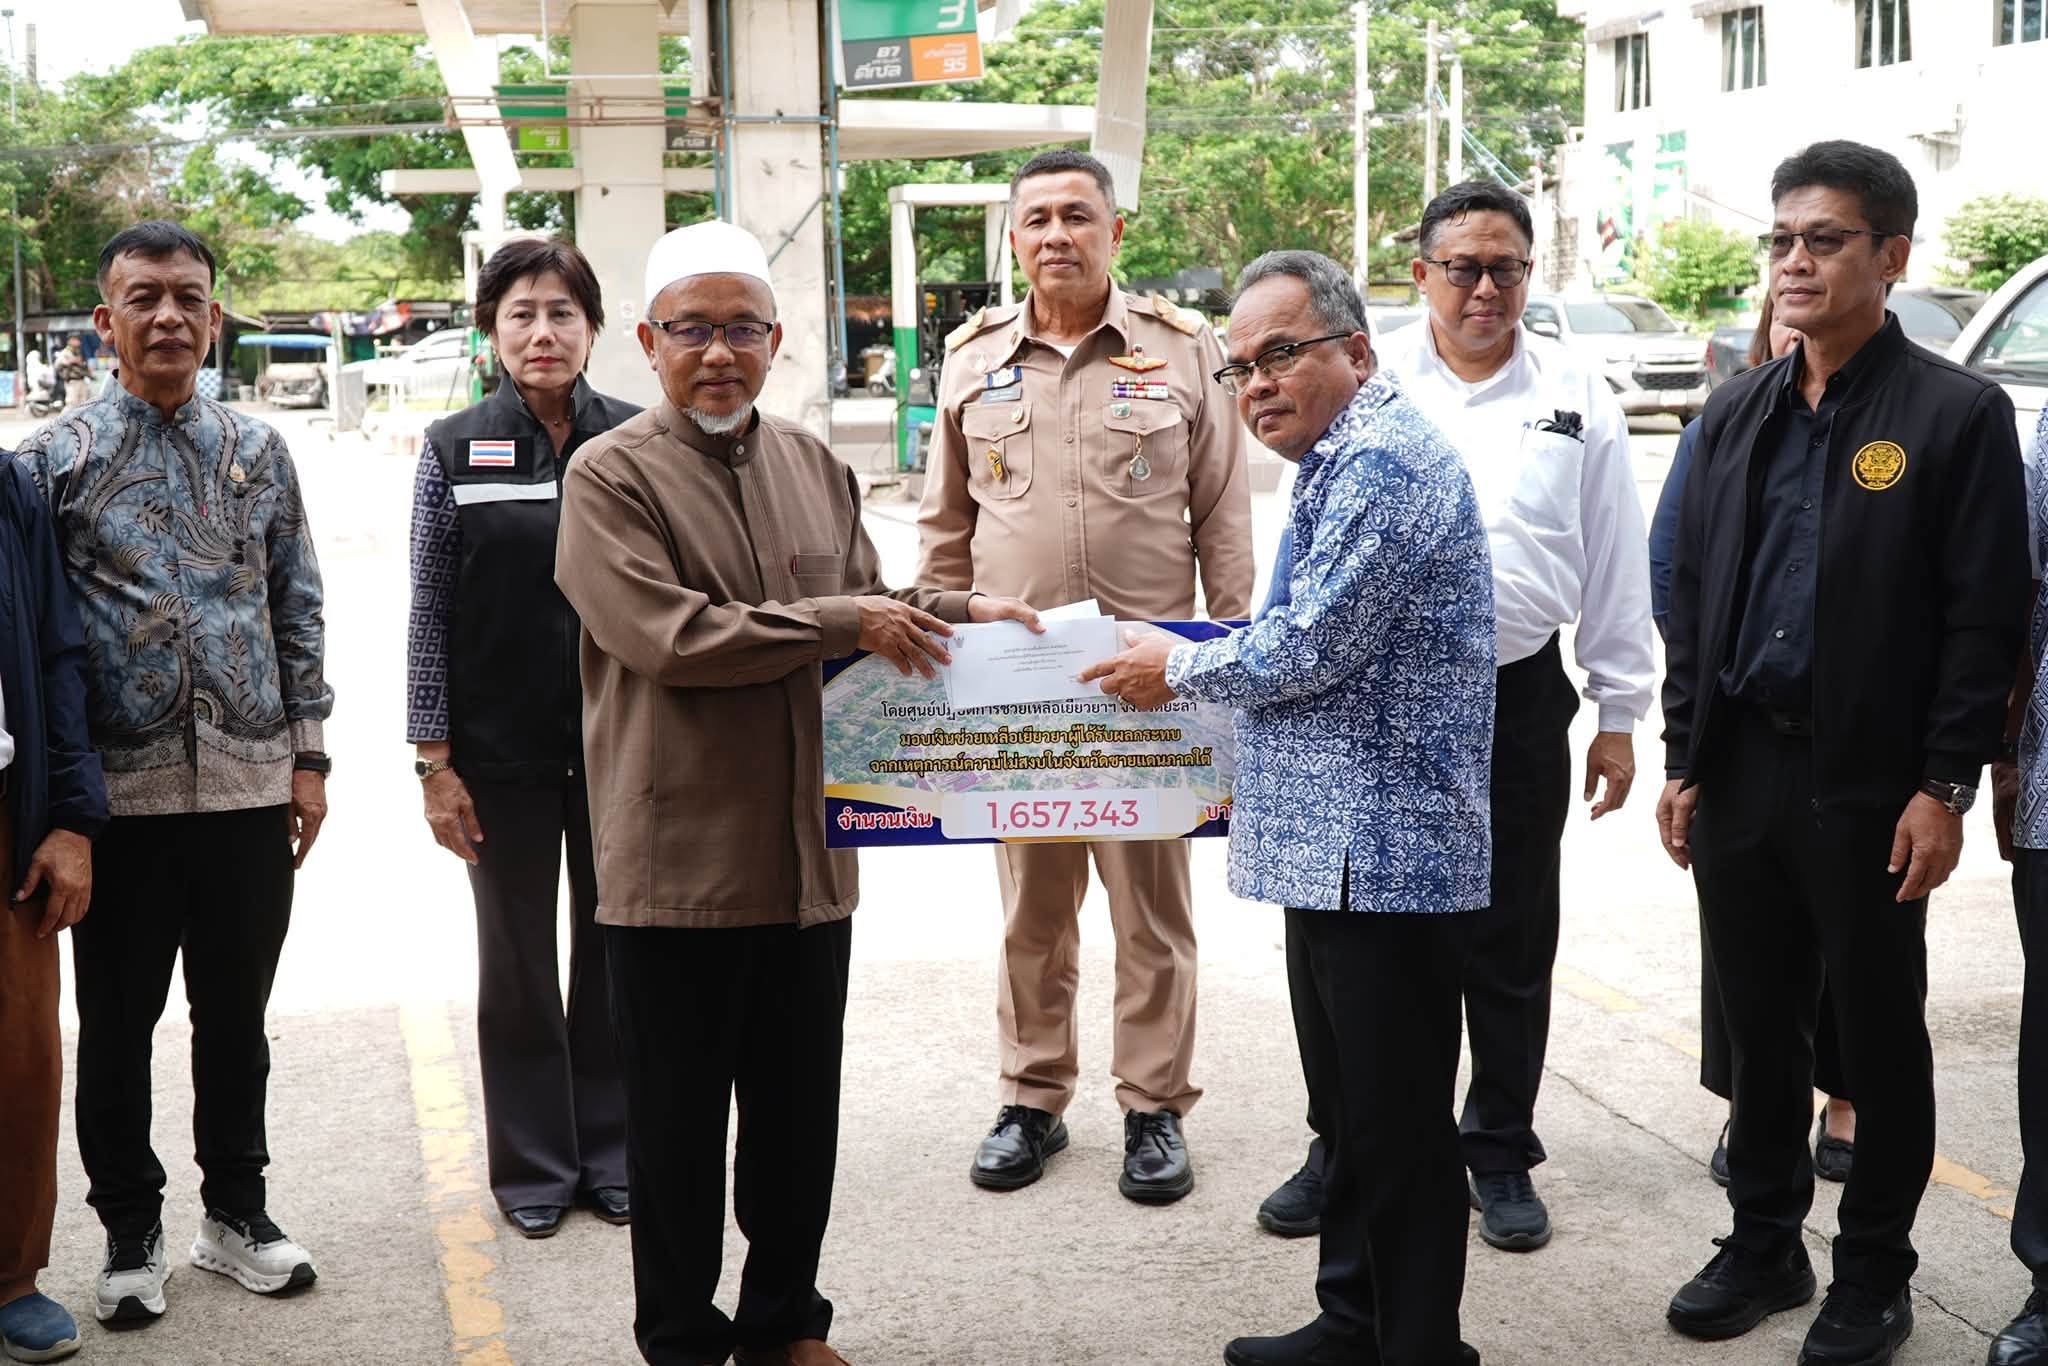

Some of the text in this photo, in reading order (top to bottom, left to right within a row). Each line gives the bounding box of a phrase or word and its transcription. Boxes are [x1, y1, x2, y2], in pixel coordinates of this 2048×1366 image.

[943, 57, 968, 73] 95
[544, 134, 561, 147] 91
[900, 724, 1182, 748] มอบเงินช่วยเหลือเยียวยาผู้ได้รับผลกระทบ
[870, 747, 1213, 778] จากเหตุการณ์ความไม่สงบในจังหวัดชายแดนภาคใต้
[837, 805, 934, 830] จำนวนเงิน
[987, 799, 1140, 832] 1,657,343
[1205, 804, 1233, 820] บา
